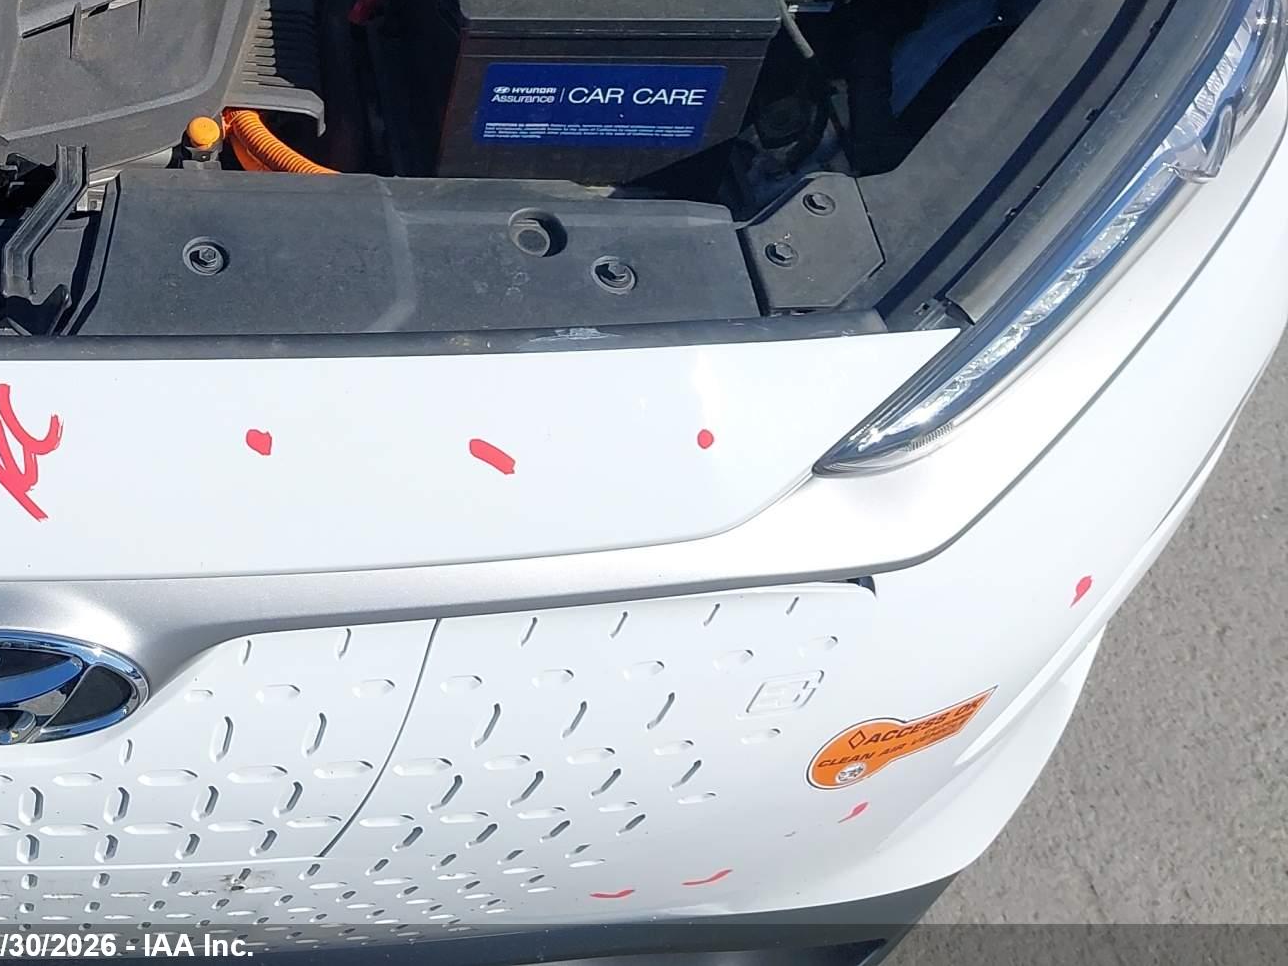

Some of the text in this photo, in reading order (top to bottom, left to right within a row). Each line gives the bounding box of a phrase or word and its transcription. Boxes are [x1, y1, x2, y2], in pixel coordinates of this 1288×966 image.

[491, 93, 555, 103] Assurance
[511, 86, 557, 94] HYUNDAI
[568, 87, 707, 106] CAR CARE
[862, 711, 950, 746] ACCESS
[816, 751, 876, 768] CLEAN
[877, 741, 907, 757] AIR
